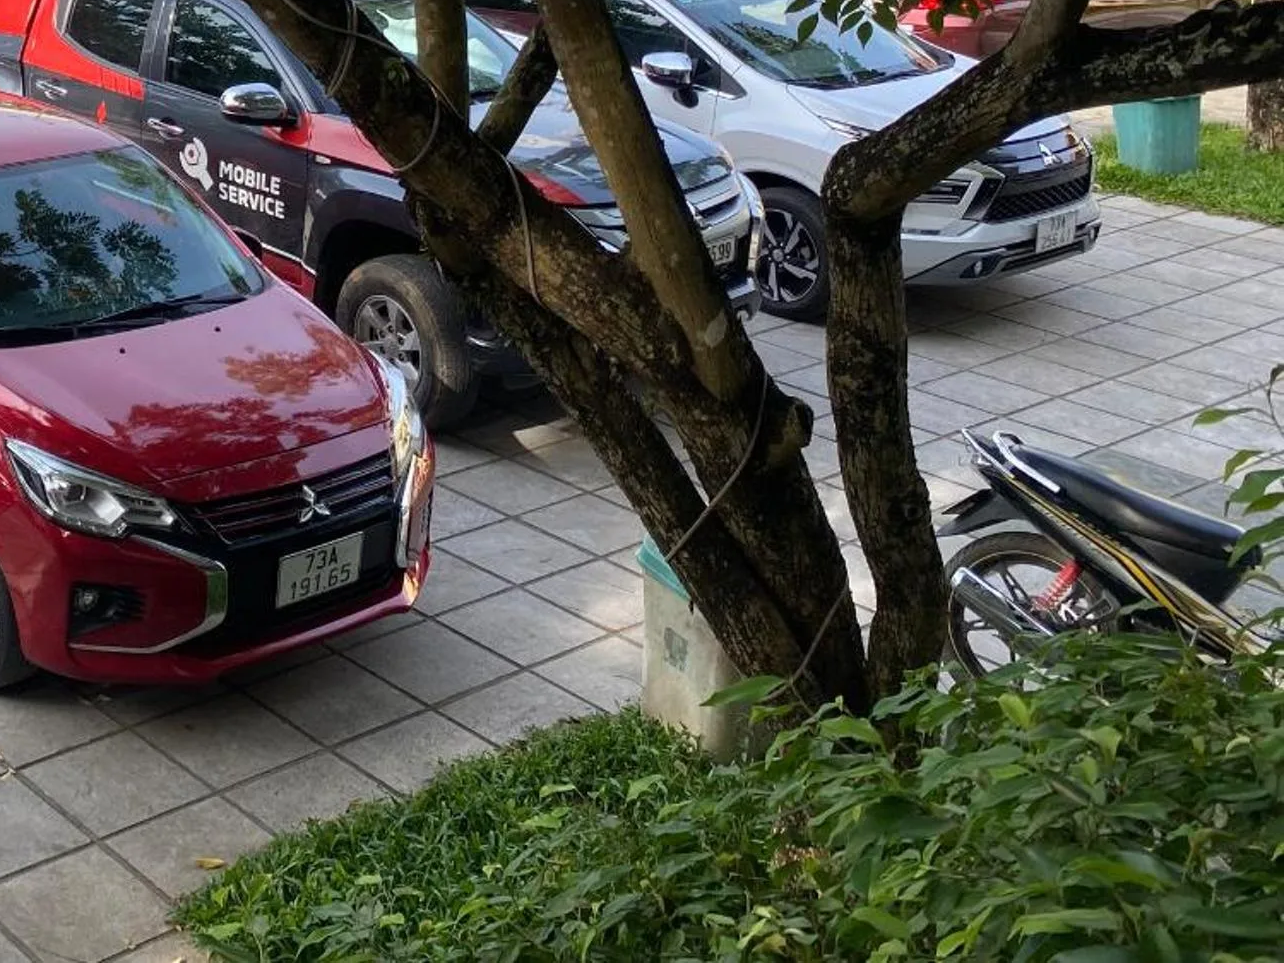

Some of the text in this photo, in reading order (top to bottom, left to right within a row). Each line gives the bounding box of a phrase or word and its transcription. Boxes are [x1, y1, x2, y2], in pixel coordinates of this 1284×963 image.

[218, 160, 281, 196] MOBILE
[218, 182, 285, 219] SERVICE
[305, 546, 338, 574] 73A
[290, 563, 352, 600] 191.65
